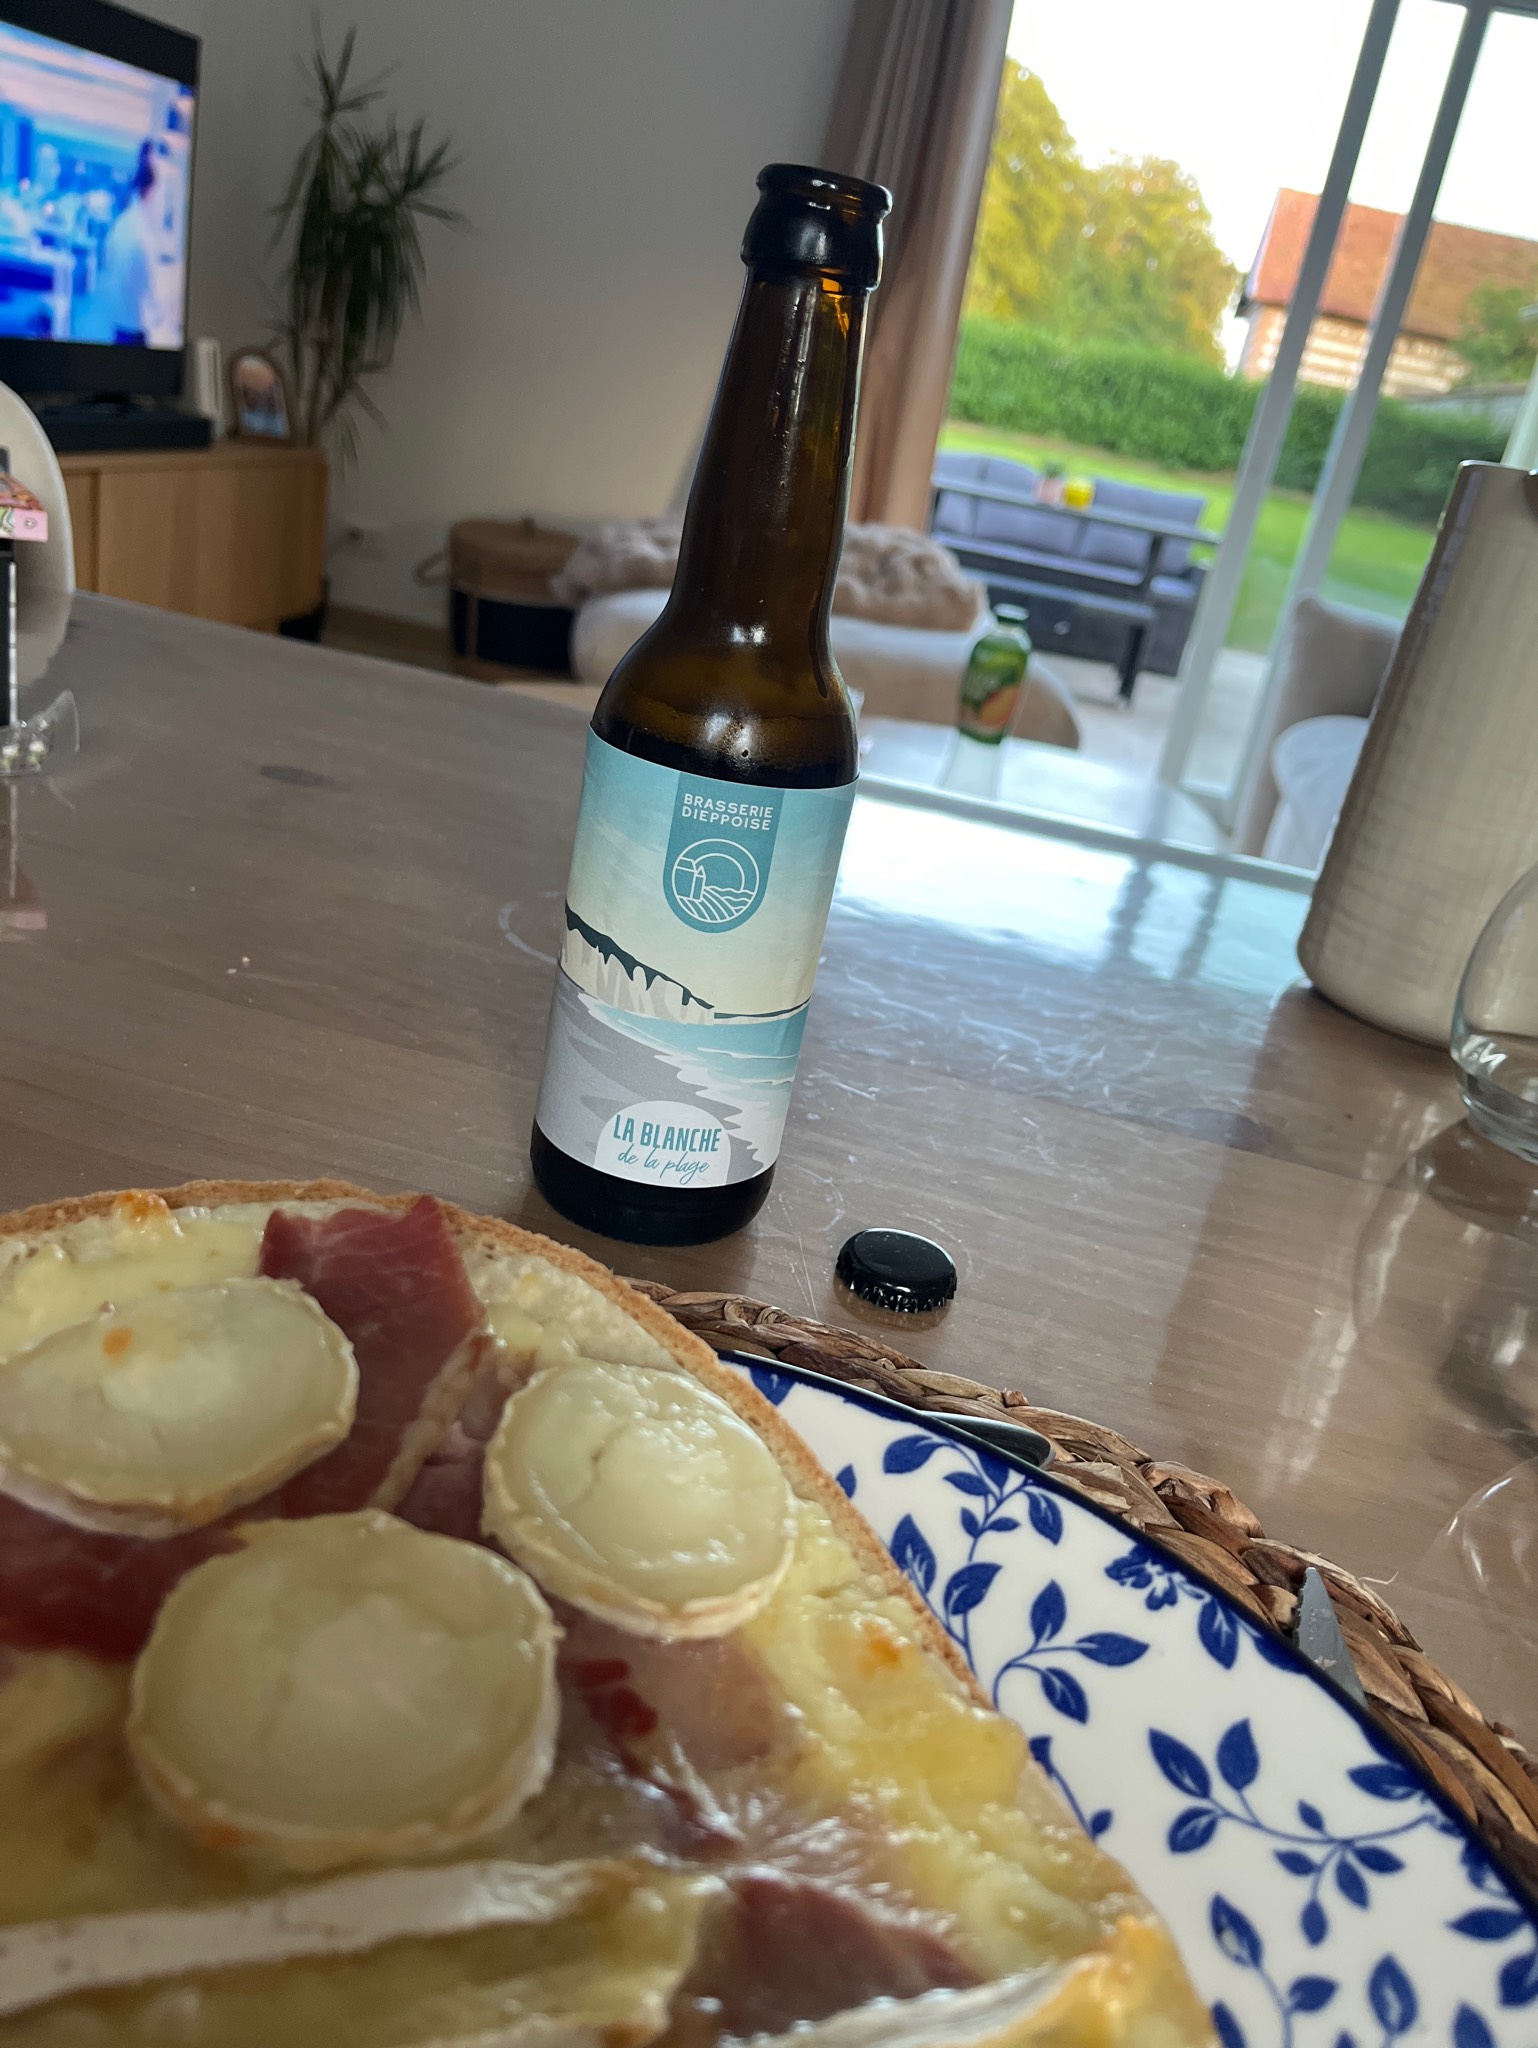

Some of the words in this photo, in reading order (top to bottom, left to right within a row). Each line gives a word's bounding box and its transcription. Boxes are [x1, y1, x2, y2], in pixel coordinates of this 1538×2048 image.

[681, 806, 771, 831] DIEPPOISE
[683, 793, 773, 818] BRASSERIE
[613, 1114, 635, 1143] LA
[640, 1121, 722, 1153] BLANCHE
[617, 1143, 638, 1165] de
[643, 1146, 660, 1169] la
[659, 1151, 709, 1185] plage
